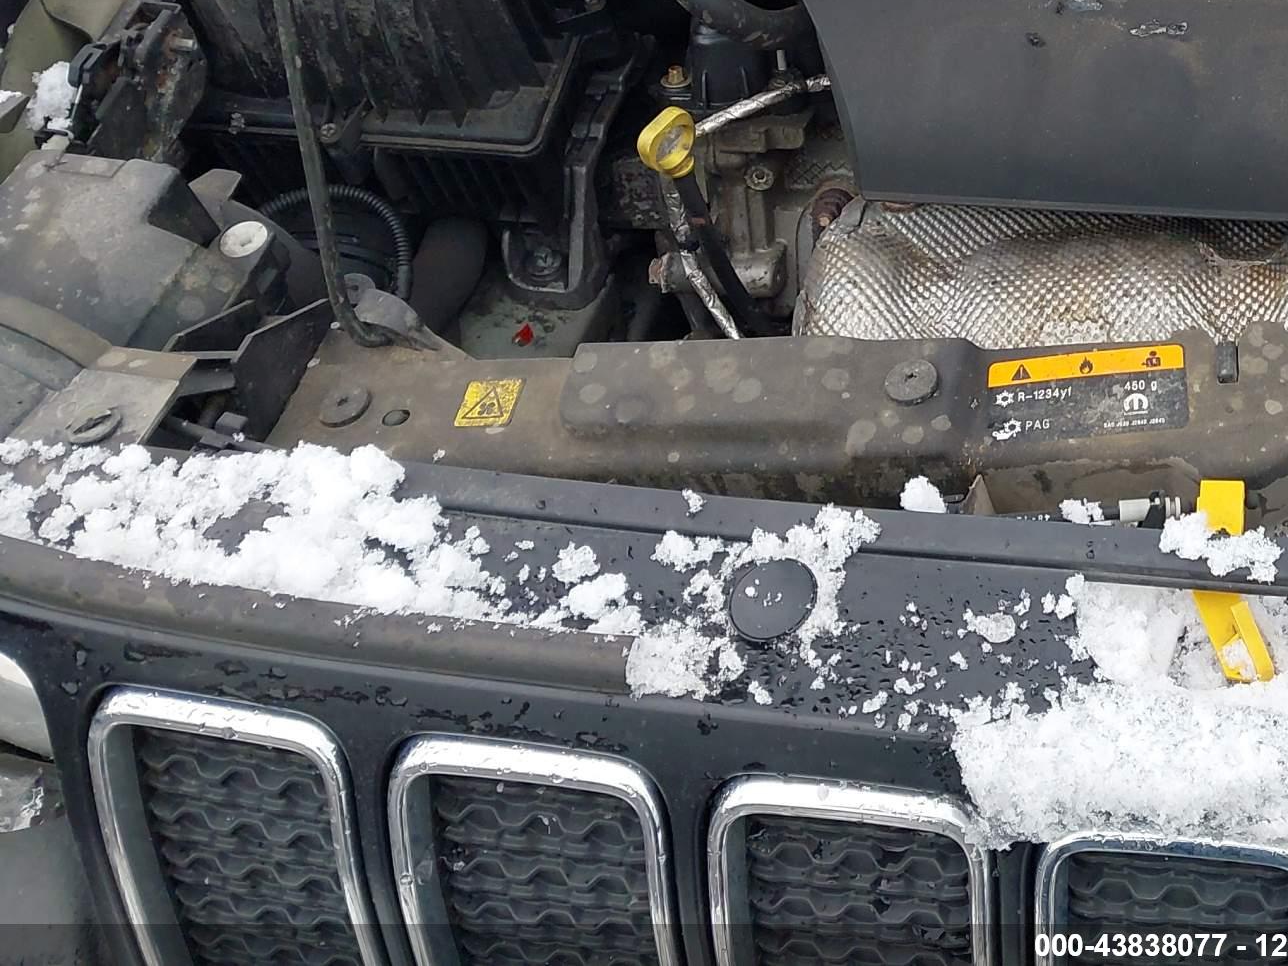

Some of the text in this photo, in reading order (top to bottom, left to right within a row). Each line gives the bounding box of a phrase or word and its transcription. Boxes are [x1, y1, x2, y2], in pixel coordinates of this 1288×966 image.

[1124, 380, 1158, 391] 450 g
[1017, 386, 1072, 402] R-1234yf
[1025, 418, 1050, 431] PAG
